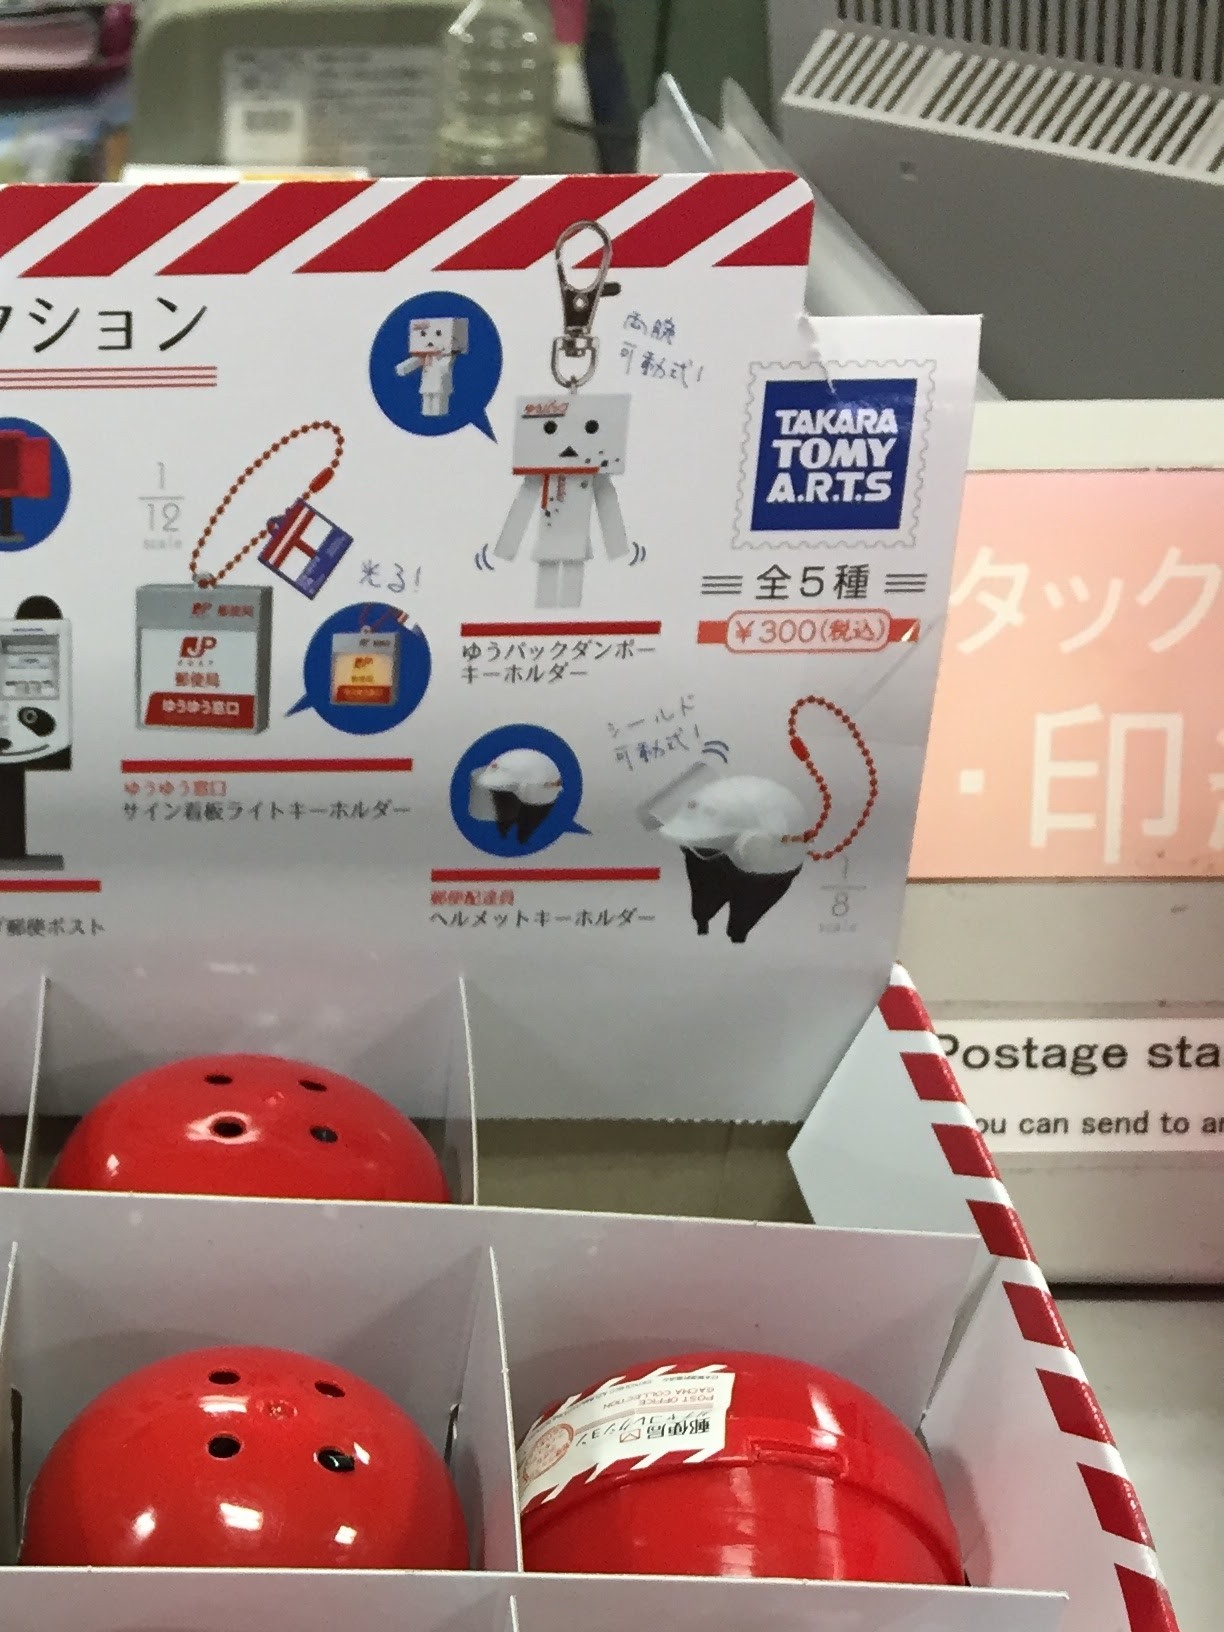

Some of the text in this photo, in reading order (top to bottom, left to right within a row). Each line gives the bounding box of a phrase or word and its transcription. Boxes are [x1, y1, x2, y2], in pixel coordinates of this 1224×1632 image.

[774, 407, 900, 437] TAKARA
[771, 437, 898, 470] TOMY
[765, 470, 894, 505] A.R.T.S
[755, 563, 871, 602] 全5種
[460, 662, 589, 685] キーホルダー
[959, 702, 1224, 867] ・印
[428, 906, 656, 930] ヘルメットキーホルダー
[974, 1117, 1007, 1134] ou
[1019, 1116, 1069, 1134] can
[1081, 1110, 1149, 1134] send
[1160, 1112, 1190, 1133] to
